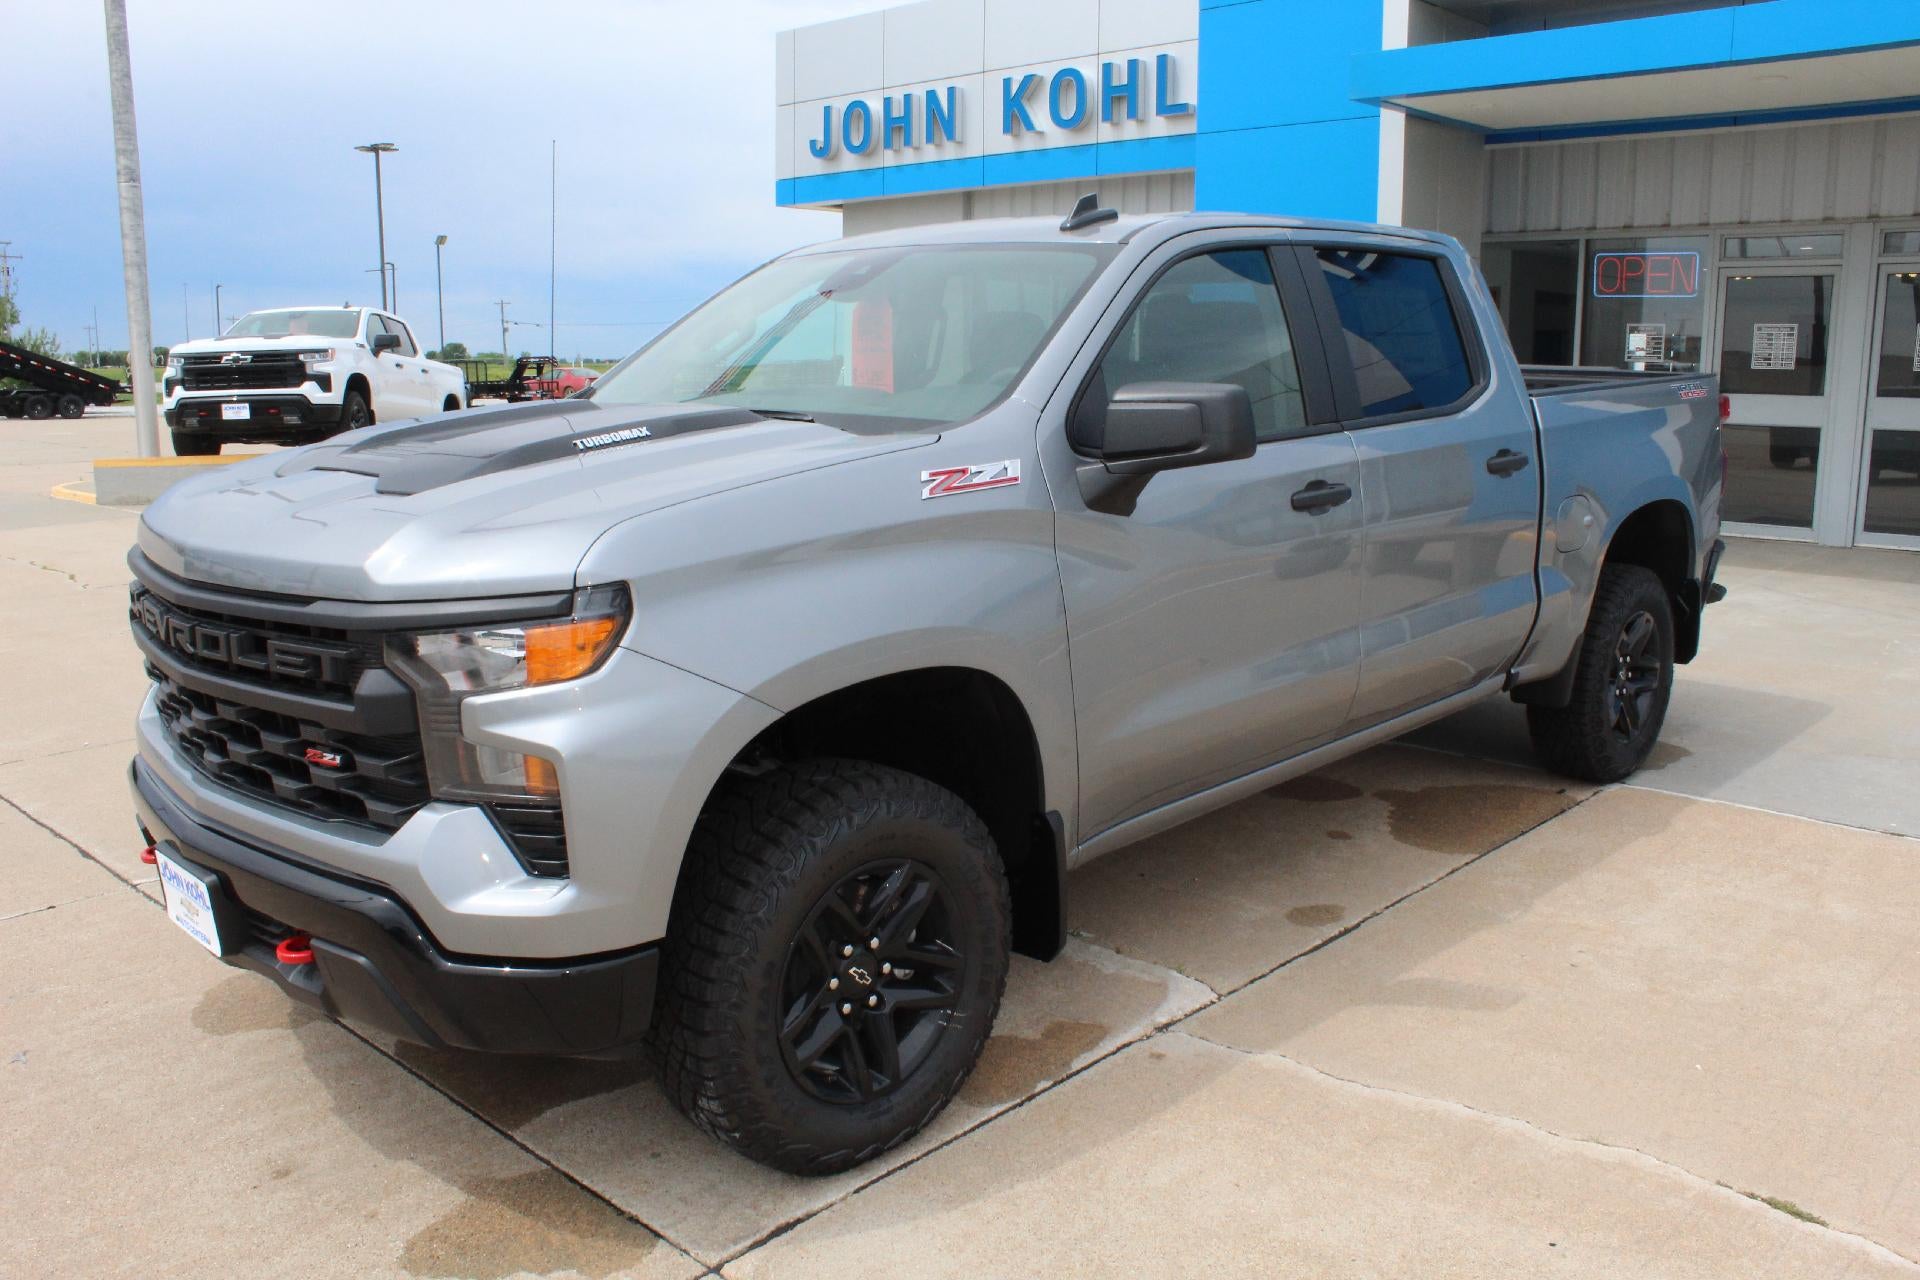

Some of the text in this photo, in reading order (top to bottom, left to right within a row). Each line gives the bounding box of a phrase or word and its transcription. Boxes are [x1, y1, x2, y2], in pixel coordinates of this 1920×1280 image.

[809, 53, 1195, 161] JOHN KOHL
[1598, 256, 1697, 294] OPEN
[572, 426, 652, 451] TURBOMAX
[920, 458, 1021, 501] Z71
[131, 590, 352, 682] HEVROLET
[160, 861, 210, 911] JOHN KOHL
